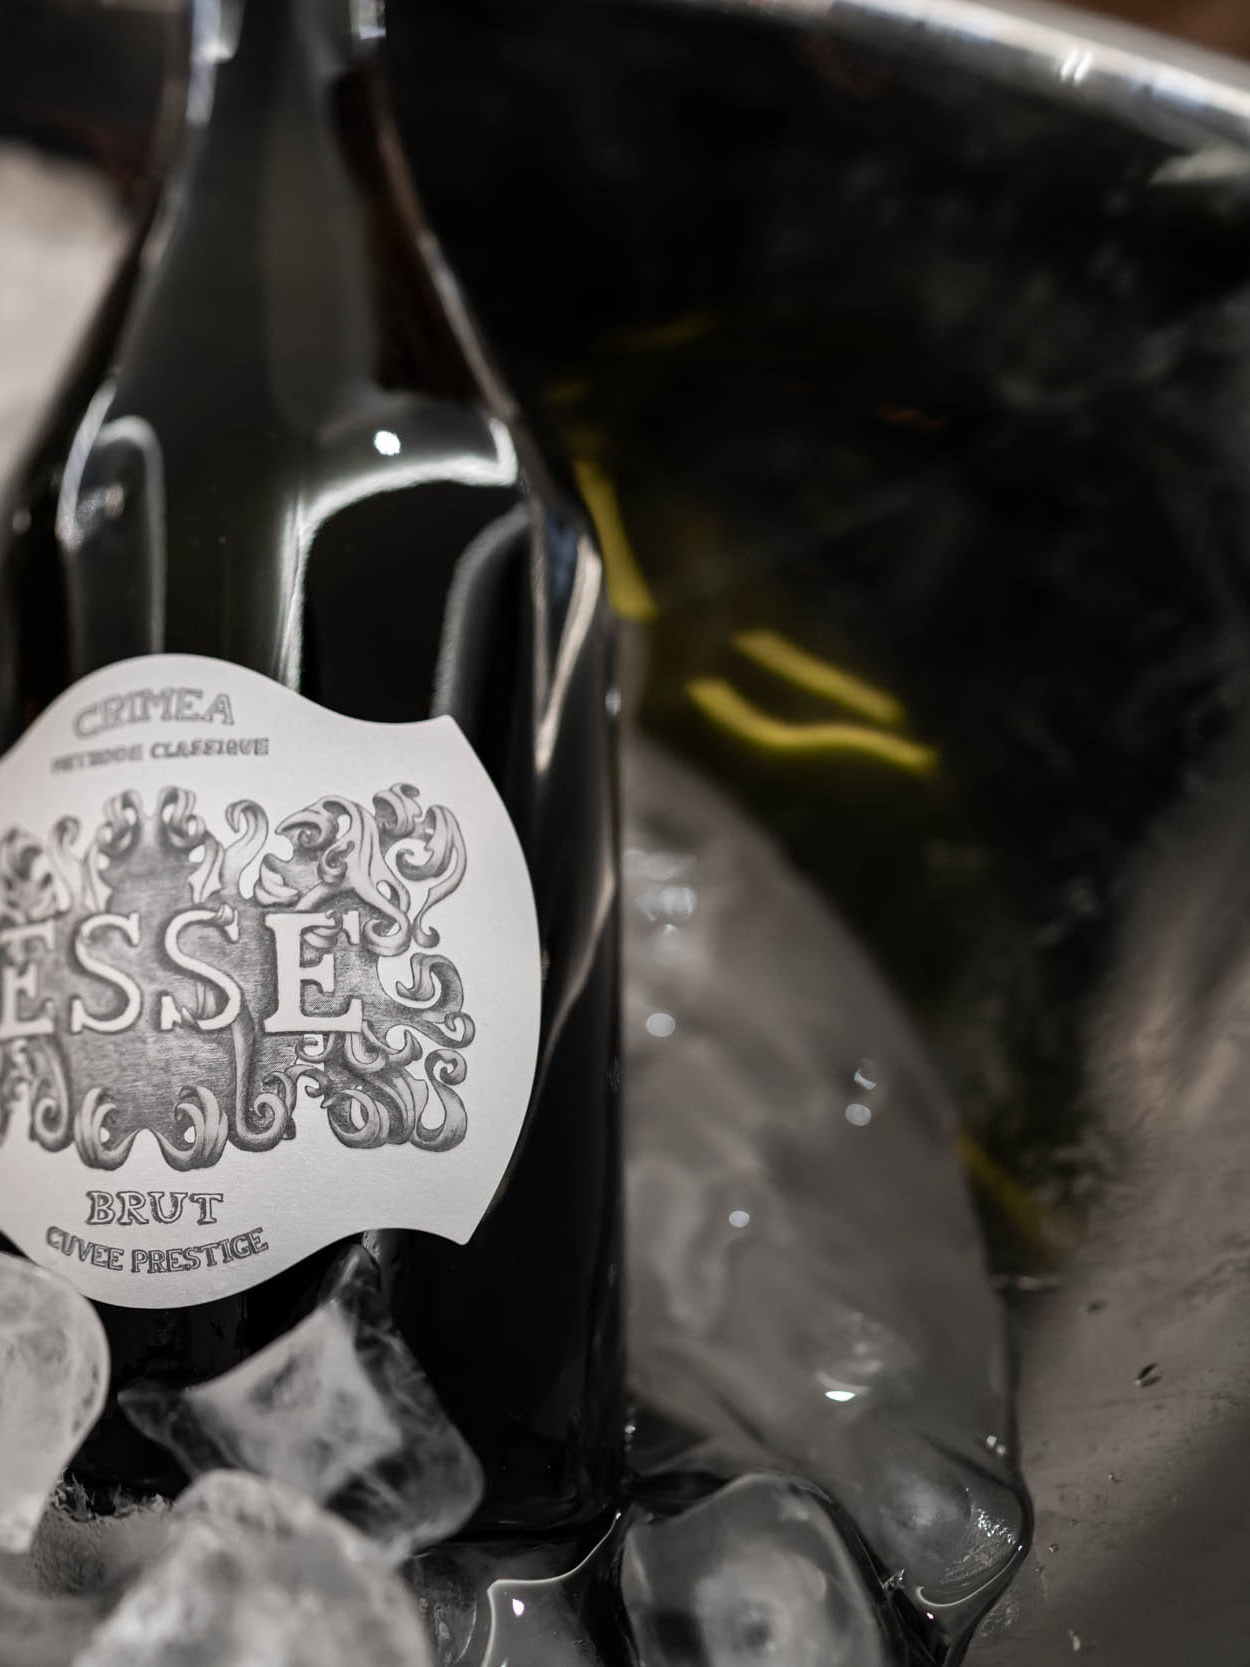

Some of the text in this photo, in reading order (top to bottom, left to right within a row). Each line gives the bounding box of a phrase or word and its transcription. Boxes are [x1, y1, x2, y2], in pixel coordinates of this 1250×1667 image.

[73, 687, 235, 738] CRIMEA
[85, 1190, 224, 1226] BRUT
[46, 1225, 269, 1274] CUVEE PRESTIGE
